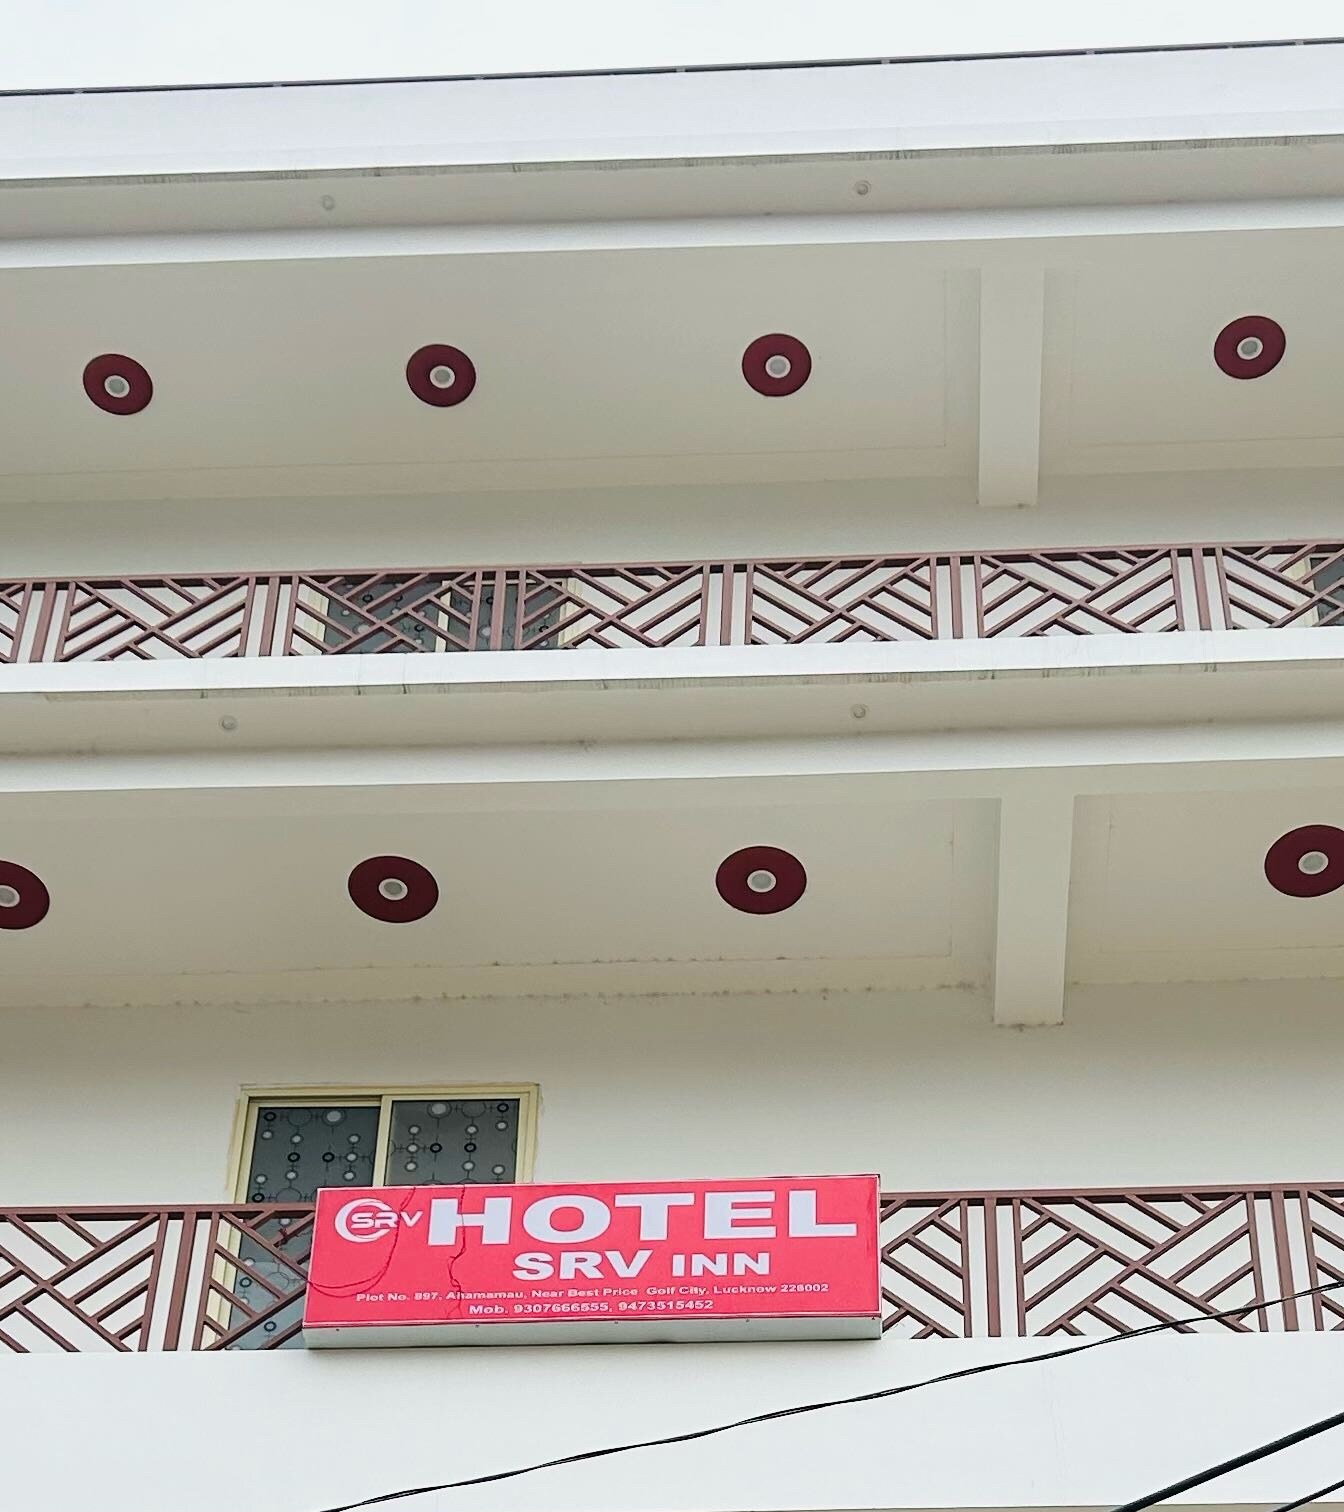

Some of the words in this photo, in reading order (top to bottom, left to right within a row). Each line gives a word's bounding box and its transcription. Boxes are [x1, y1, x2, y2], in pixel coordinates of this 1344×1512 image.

[351, 1210, 423, 1228] SRV
[427, 1190, 857, 1246] HOTEL
[512, 1249, 653, 1281] SRV
[671, 1252, 770, 1277] INN
[355, 1293, 384, 1302] Plot
[531, 1289, 564, 1298] Near
[567, 1288, 599, 1298] Best
[602, 1287, 639, 1297] Price
[646, 1286, 676, 1295] Golf
[713, 1285, 777, 1294] Lucknow
[468, 1304, 509, 1315] Mob.
